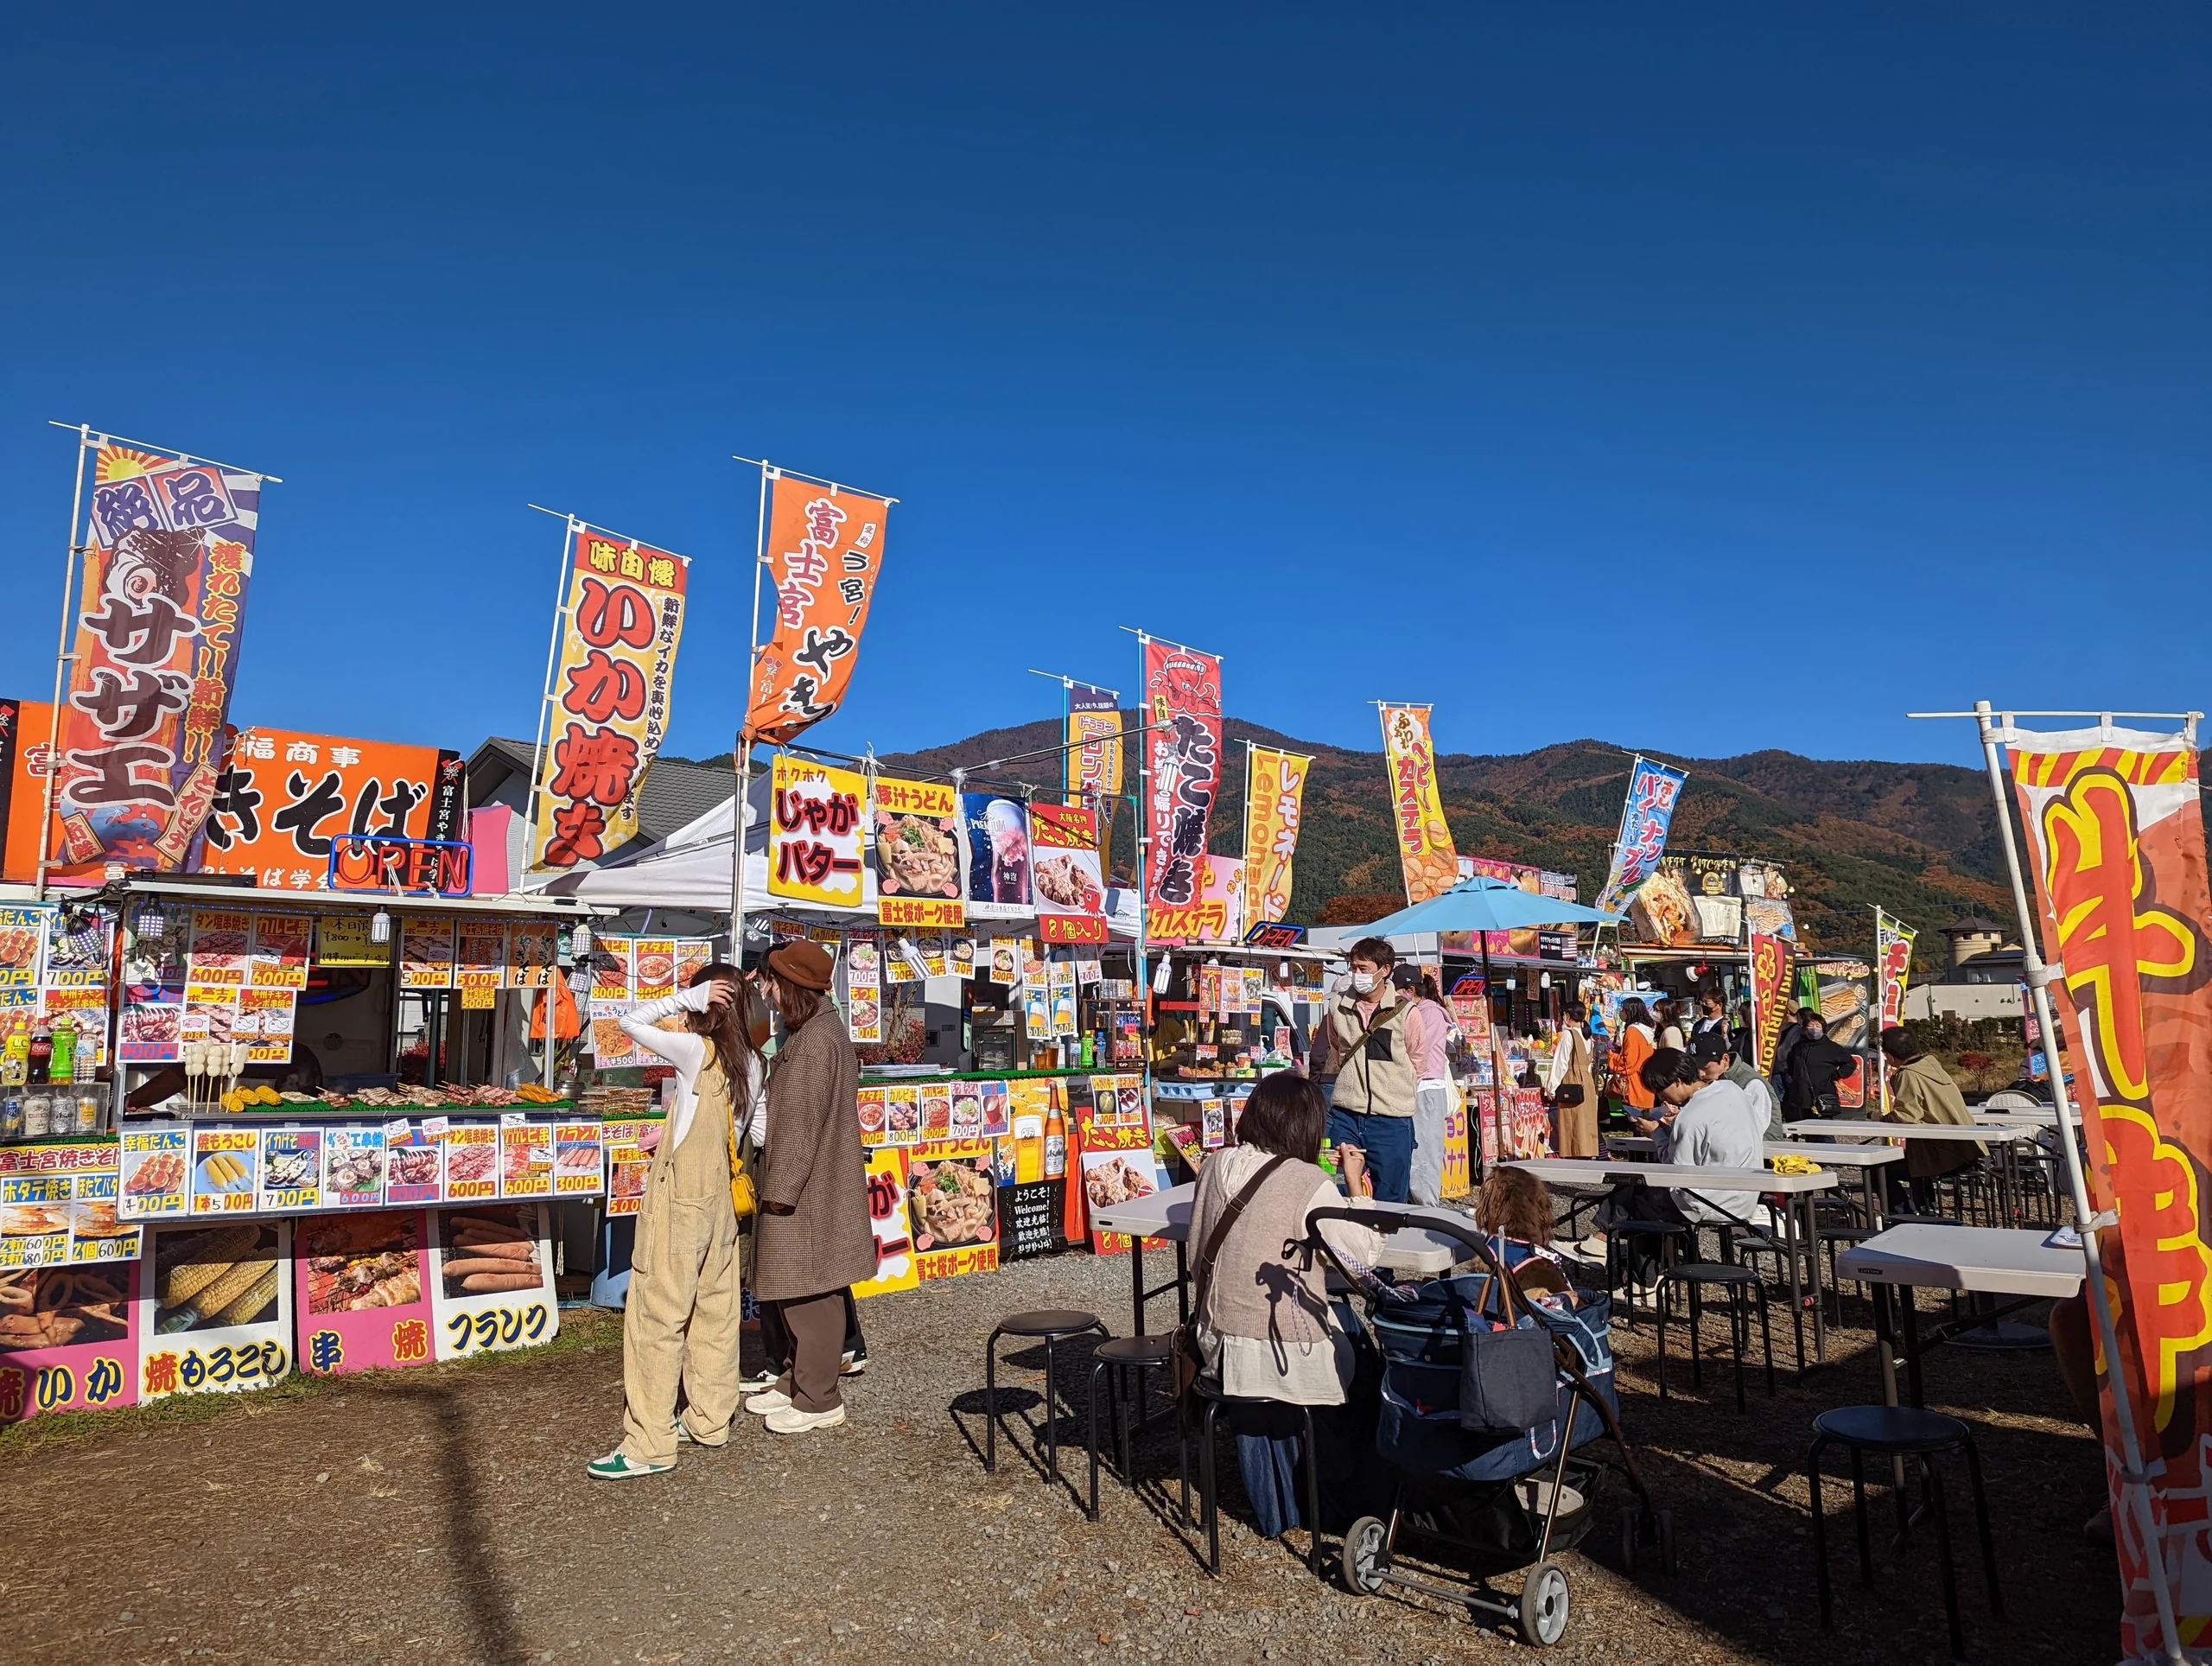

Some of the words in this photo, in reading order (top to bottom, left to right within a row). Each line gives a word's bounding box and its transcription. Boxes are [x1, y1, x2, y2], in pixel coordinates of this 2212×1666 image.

[94, 471, 226, 541] 絶品
[589, 539, 677, 588] 味自慢
[778, 498, 847, 629] 富士宮
[63, 593, 201, 810] サザエ
[1155, 696, 1166, 730] 味自
[545, 575, 657, 867] いか焼き
[1079, 715, 1116, 733] ドラゴン
[776, 767, 826, 783] ホクホク
[1411, 741, 1432, 811] ベビー
[874, 785, 954, 813] 豚汁うどん
[1396, 755, 1423, 854] カステラ
[776, 789, 859, 836] じゃが
[1058, 812, 1088, 824] 大阪名物
[1159, 715, 1216, 906] たこ焼き
[1032, 811, 1096, 849] たこ焼き
[1618, 772, 1664, 886] パイナップル
[1262, 758, 1301, 923] レモネード
[339, 843, 467, 890] OPEN
[777, 842, 861, 884] バター
[1003, 871, 1018, 882] 神泡
[880, 901, 963, 925] 富士桜ポーク使用
[195, 912, 250, 931] タン塩串焼き
[257, 918, 309, 935] カルビ串
[460, 923, 504, 935] 富士宮焼そば
[772, 921, 804, 935] みそおでん
[1047, 918, 1103, 941] 8個入り
[1251, 925, 1299, 947] OPEN
[593, 940, 630, 953] カルビ丼
[637, 942, 674, 953] ブタ丼
[513, 936, 531, 986] やきそば
[537, 936, 554, 985] やきそば
[189, 968, 245, 983] 600円
[849, 971, 878, 982] 700円
[950, 963, 973, 975] 700円
[992, 971, 1015, 982] 500円
[1079, 970, 1101, 981] 200円
[1780, 954, 1794, 993] FURI
[251, 971, 305, 986] 600円
[402, 972, 448, 985] 500円
[457, 973, 501, 985] 500円
[1024, 975, 1046, 983] 500円
[60, 989, 103, 1000] 甲州チキン
[251, 989, 290, 1000] 甲州チキン
[462, 987, 495, 999] 富士宮焼そば
[593, 987, 627, 999] 800円
[637, 987, 674, 999] 800円
[850, 988, 878, 1000] もつ煮
[1052, 988, 1074, 999] 生ビール
[1454, 979, 1484, 995] OPEN
[45, 999, 107, 1008] ジャンボ串焼き
[239, 998, 292, 1008] ジャンボ串焼き
[462, 999, 495, 1008] 500円
[851, 1027, 879, 1039] 500円
[1028, 1027, 1050, 1038] 600円
[1052, 1023, 1075, 1034] 600円
[119, 1044, 178, 1059] 900円
[611, 1056, 633, 1065] ¥500
[857, 1091, 886, 1103] ブタ丼
[888, 1088, 918, 1102] カルビ丼
[921, 1086, 950, 1097] カルビ丼
[1096, 1115, 1116, 1124] 500円
[388, 1131, 413, 1146] CHICKEN
[426, 1133, 449, 1142] PORK
[448, 1127, 497, 1145] タン塩串焼き
[556, 1126, 601, 1141] フランク
[888, 1130, 918, 1142] 800円
[923, 1127, 950, 1138] 800円
[952, 1125, 979, 1137] 700円
[1080, 1117, 1148, 1148] たこ焼き
[124, 1134, 186, 1151] 幸福だんご
[197, 1133, 257, 1151] 焼もろこし
[1047, 1148, 1064, 1158] Asahi
[3, 1179, 71, 1202] ホタテ焼き
[448, 1182, 495, 1197] 600円
[504, 1179, 551, 1194] 600円
[556, 1176, 601, 1192] 300円
[266, 1188, 319, 1206] 700円
[340, 1192, 380, 1204] 600円
[389, 1186, 436, 1200] 900円
[1014, 1186, 1050, 1202] ようこそ!
[1014, 1199, 1050, 1215] Welcome!
[73, 1237, 138, 1261] 2個600円
[1018, 1239, 1052, 1254] 환영합니다!
[916, 1248, 997, 1281] 富士桜ポーク使用
[447, 1301, 549, 1351] フランク
[145, 1339, 289, 1394] 焼もろこし
